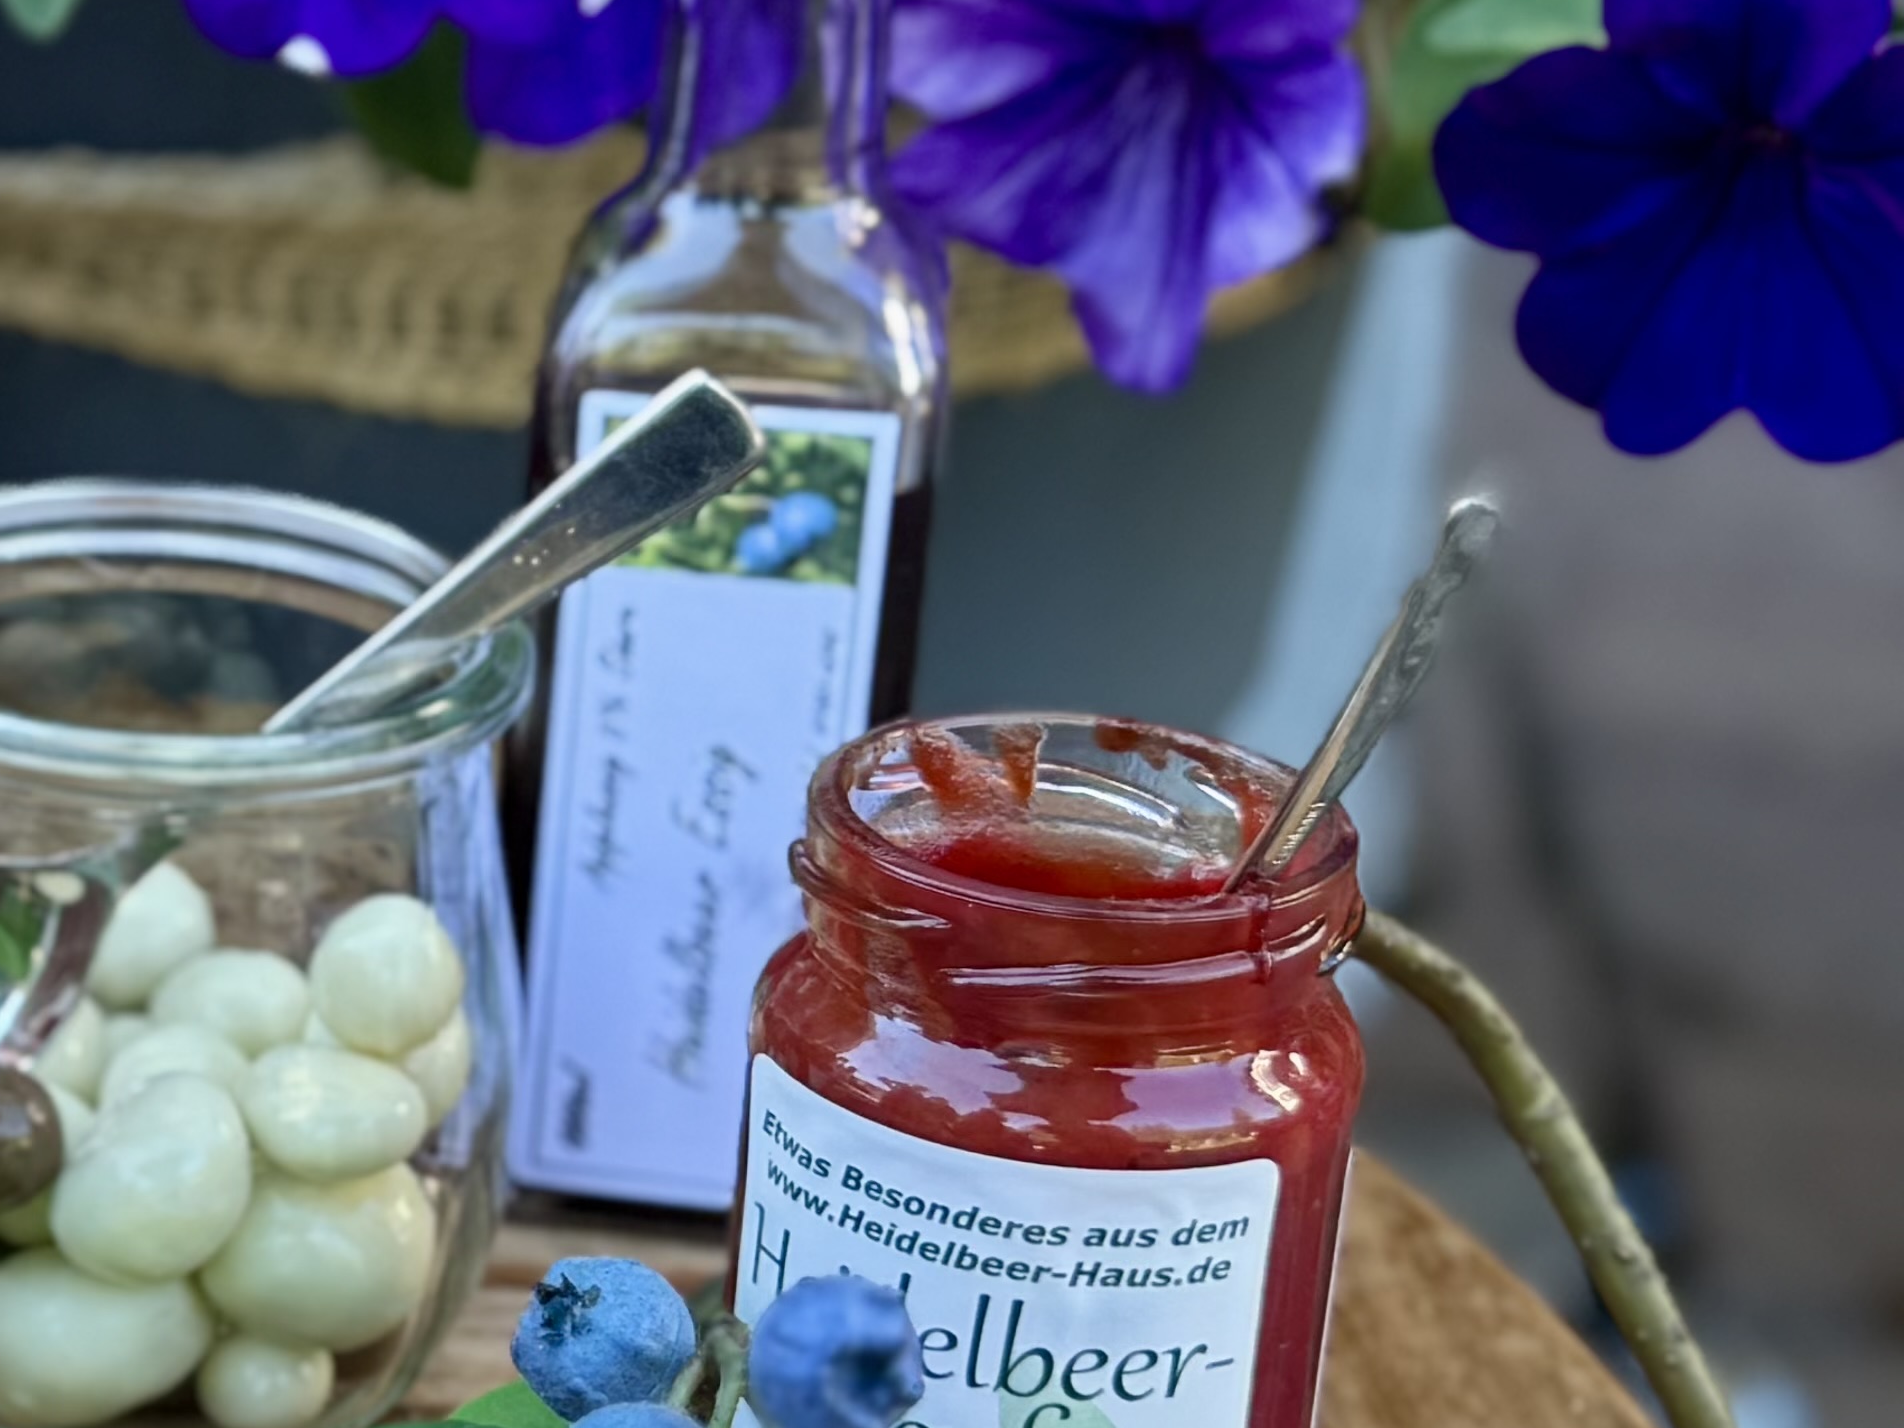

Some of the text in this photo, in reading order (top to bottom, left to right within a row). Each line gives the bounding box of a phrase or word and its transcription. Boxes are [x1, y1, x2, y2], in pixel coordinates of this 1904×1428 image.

[762, 1109, 1250, 1249] Etwas Besonderes aus dem
[766, 1156, 1232, 1290] www.Heidelbeer-Haus.de
